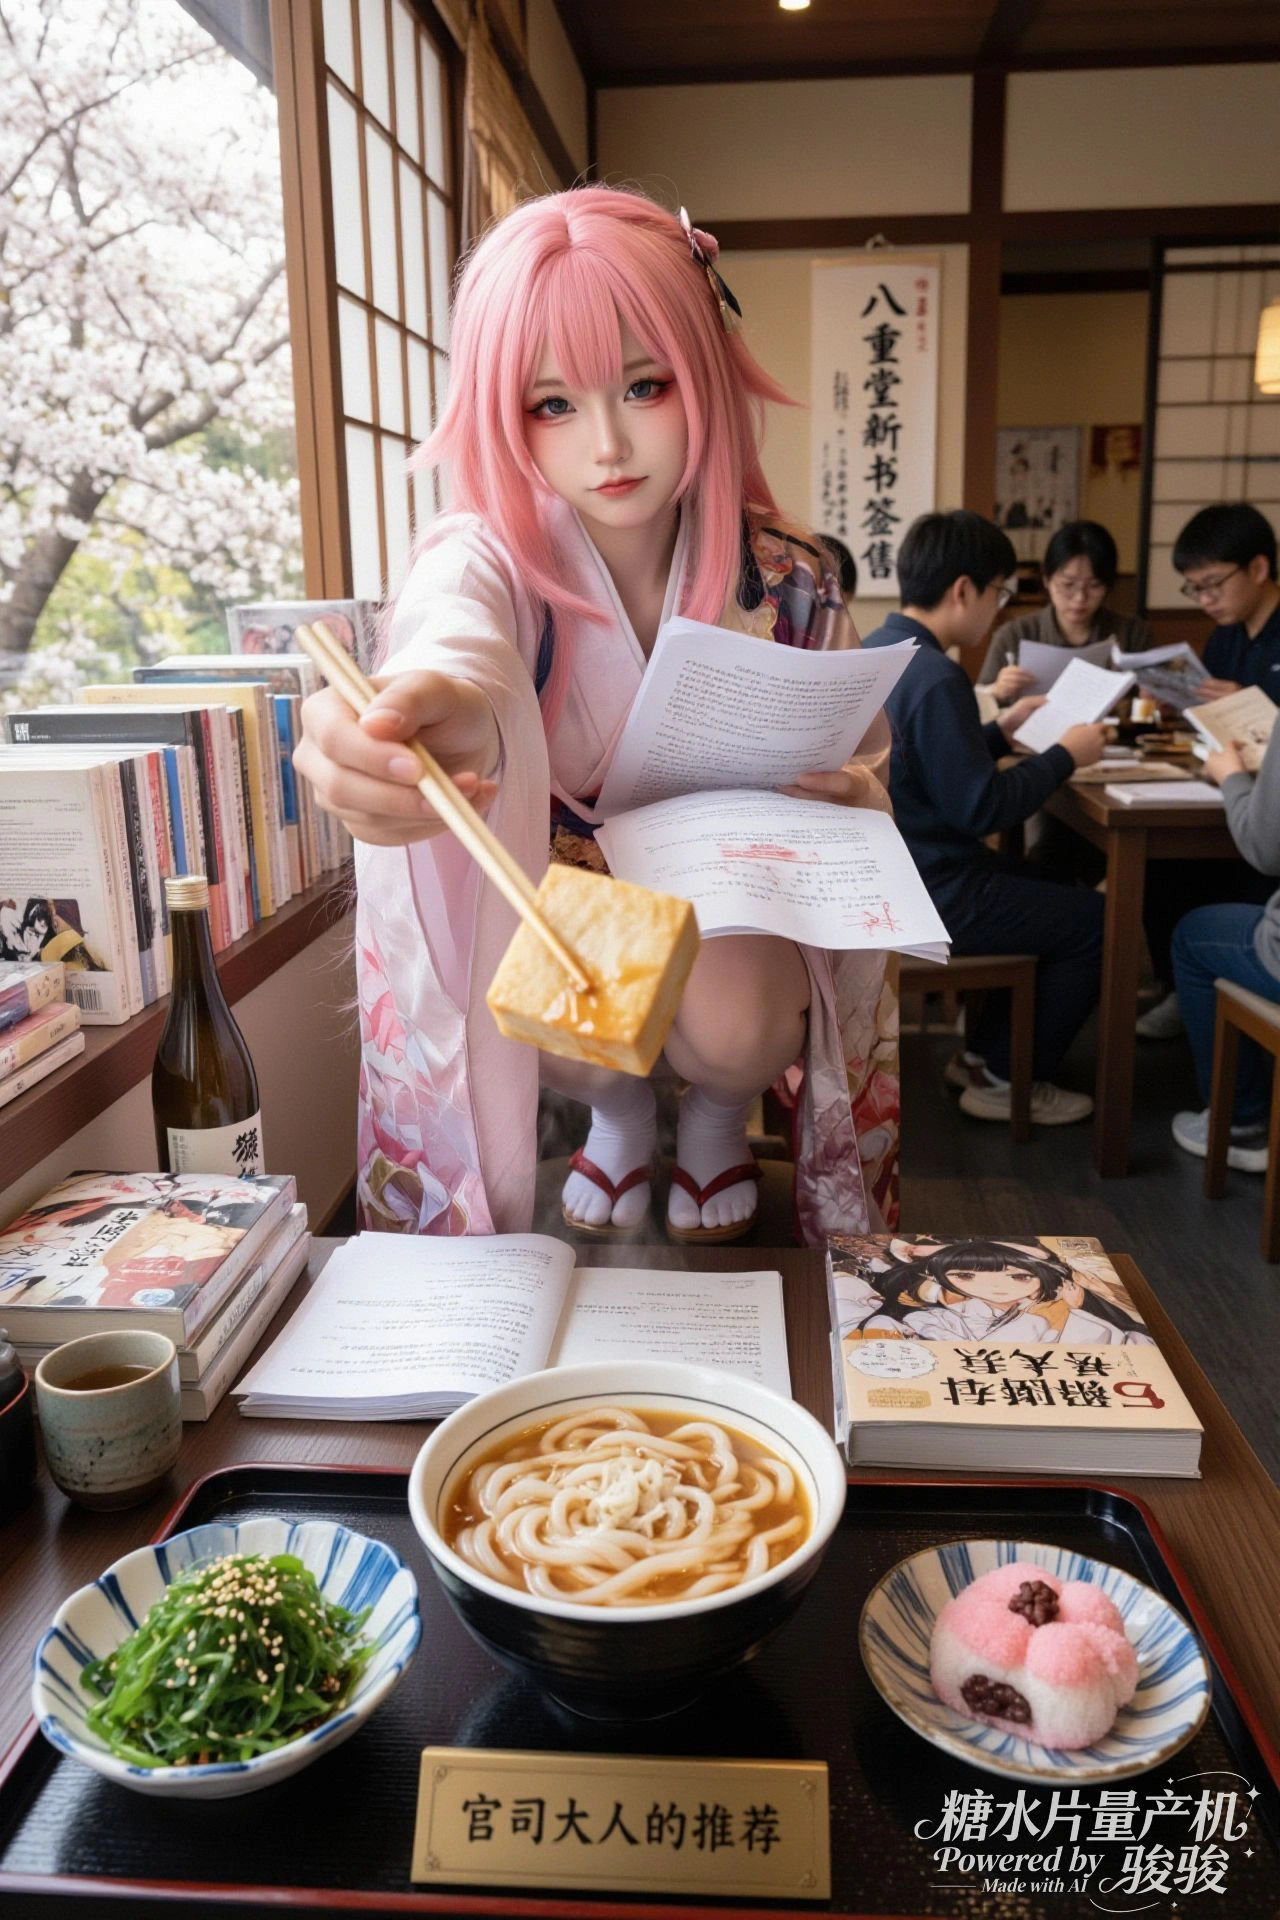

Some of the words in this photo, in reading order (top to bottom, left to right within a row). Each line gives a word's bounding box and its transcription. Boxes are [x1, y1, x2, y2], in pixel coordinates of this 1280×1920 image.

[861, 283, 907, 579] 八重堂新书签售
[462, 1793, 783, 1855] 官司大人的推荐
